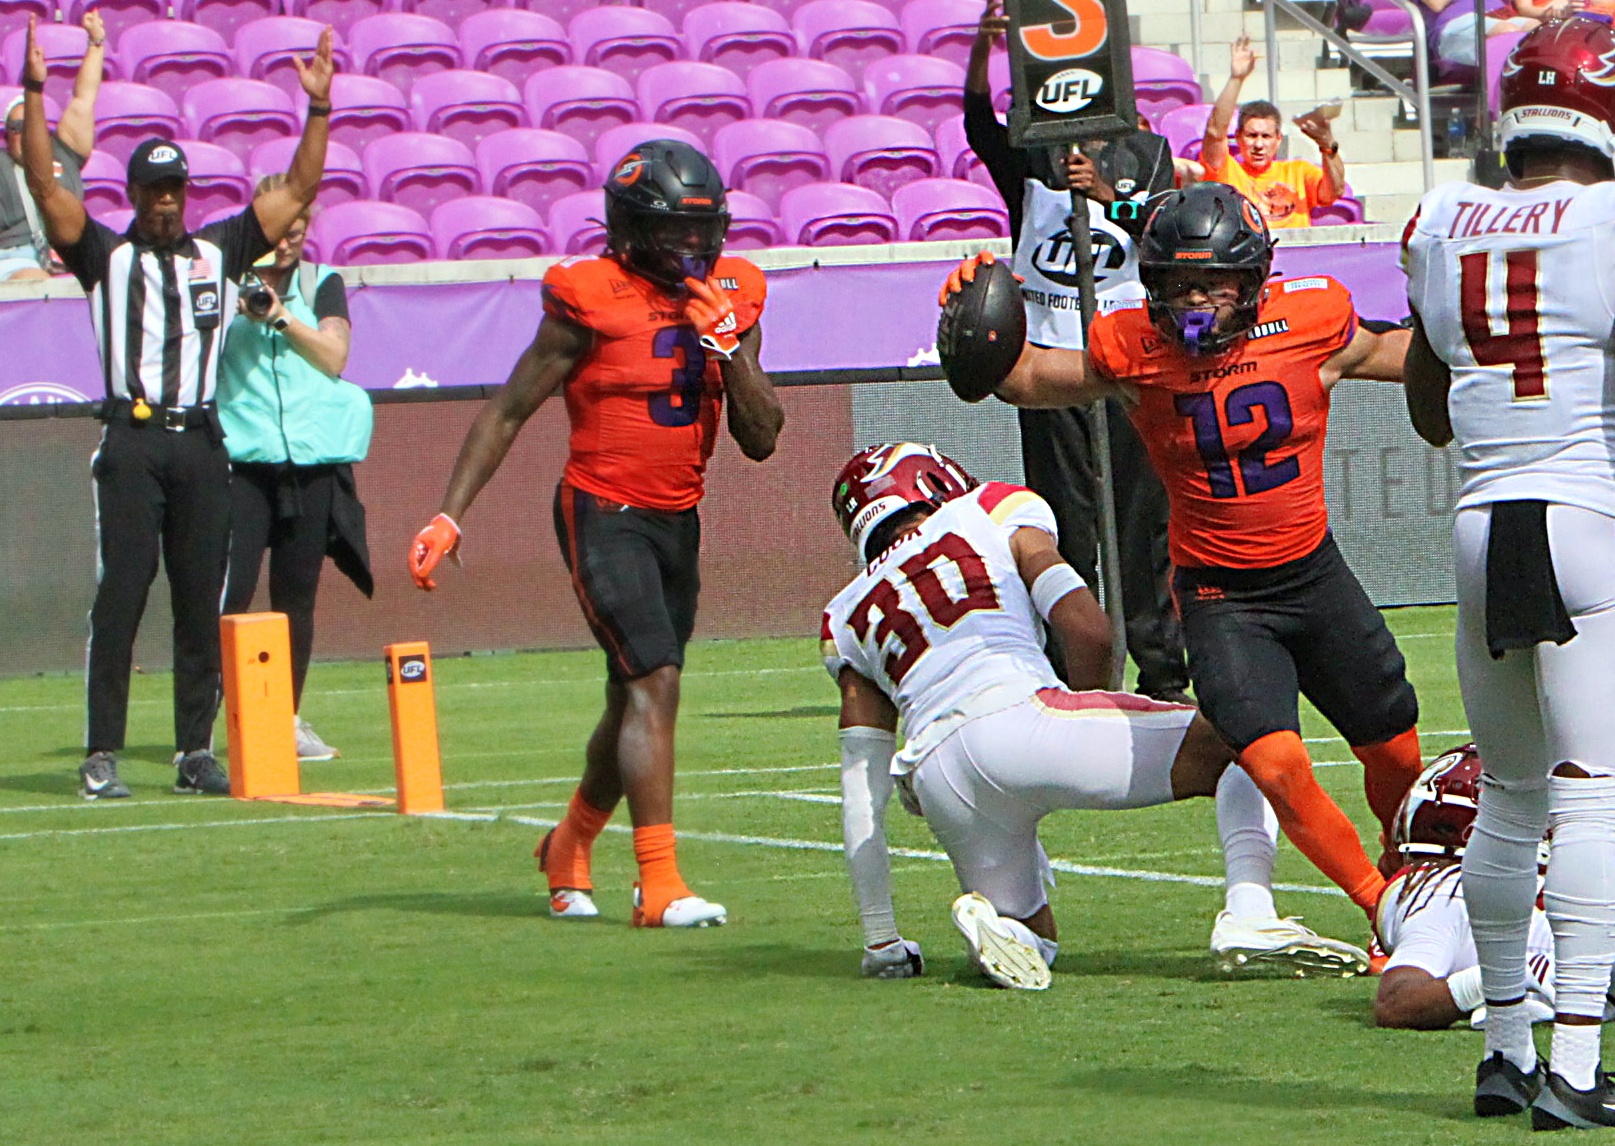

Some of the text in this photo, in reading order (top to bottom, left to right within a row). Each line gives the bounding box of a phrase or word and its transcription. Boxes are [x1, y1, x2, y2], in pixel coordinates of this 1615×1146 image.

[1538, 71, 1556, 85] LH
[1041, 79, 1100, 105] UFL
[1521, 108, 1573, 120] STALLIONS
[151, 150, 177, 160] UFL
[1448, 198, 1574, 239] TILLERY
[1456, 247, 1550, 402] 4
[648, 324, 706, 427] 3
[1189, 361, 1257, 382] STORM
[1173, 380, 1300, 498] 12
[845, 531, 1004, 687] 30
[403, 664, 424, 674] UFL
